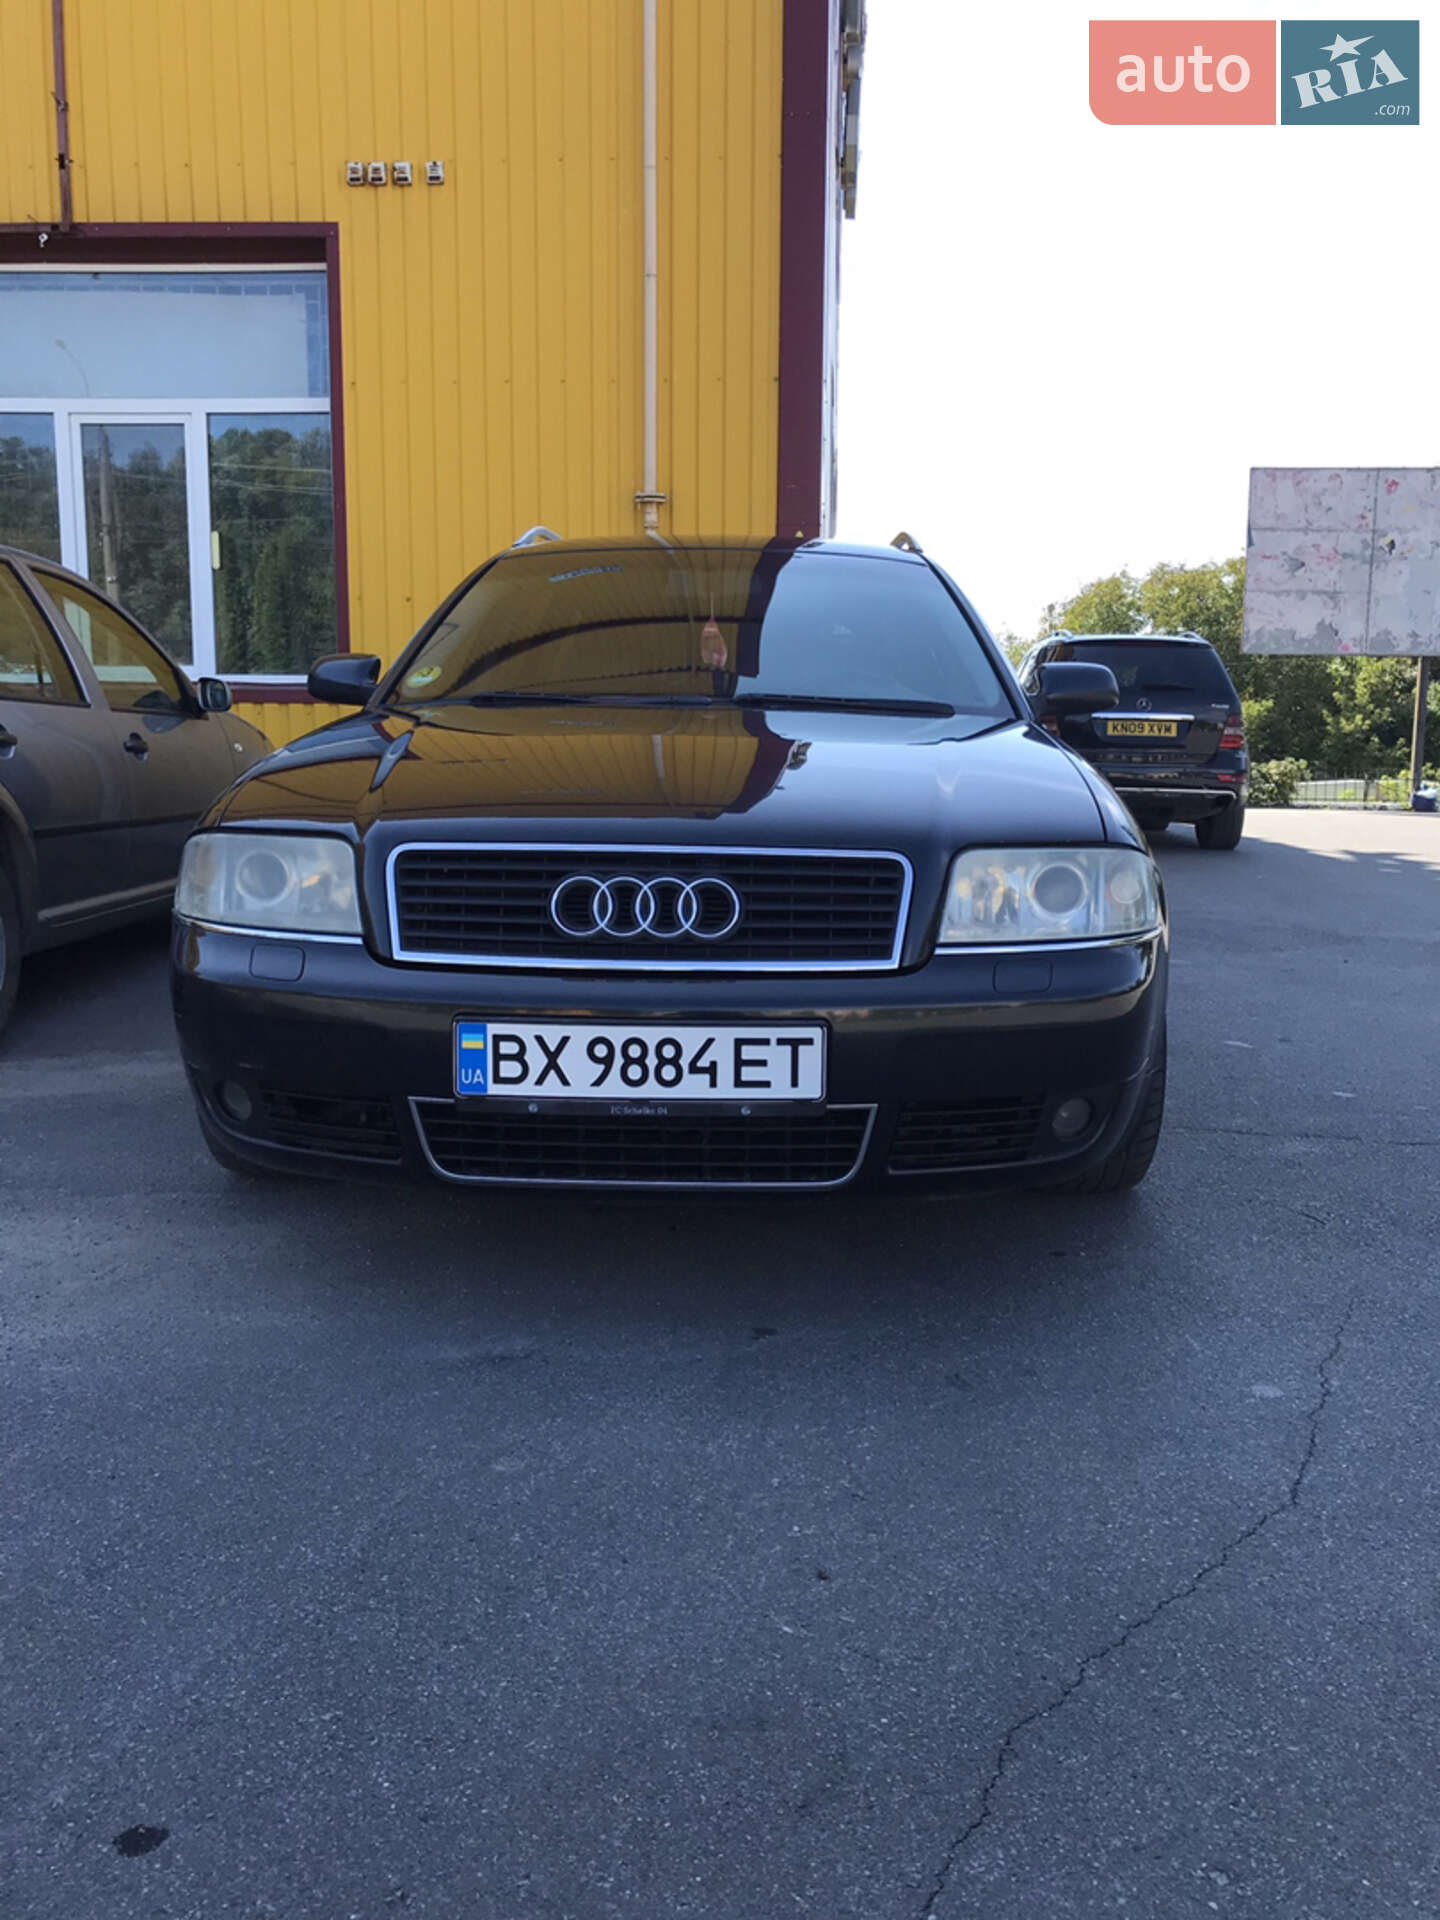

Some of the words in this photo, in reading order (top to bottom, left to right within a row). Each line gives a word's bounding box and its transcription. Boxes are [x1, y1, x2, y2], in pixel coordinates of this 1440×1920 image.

[1112, 722, 1145, 734] KN09
[492, 1034, 572, 1087] BX
[586, 1036, 718, 1088] 9884
[734, 1037, 815, 1089] ET
[461, 1068, 485, 1085] UA
